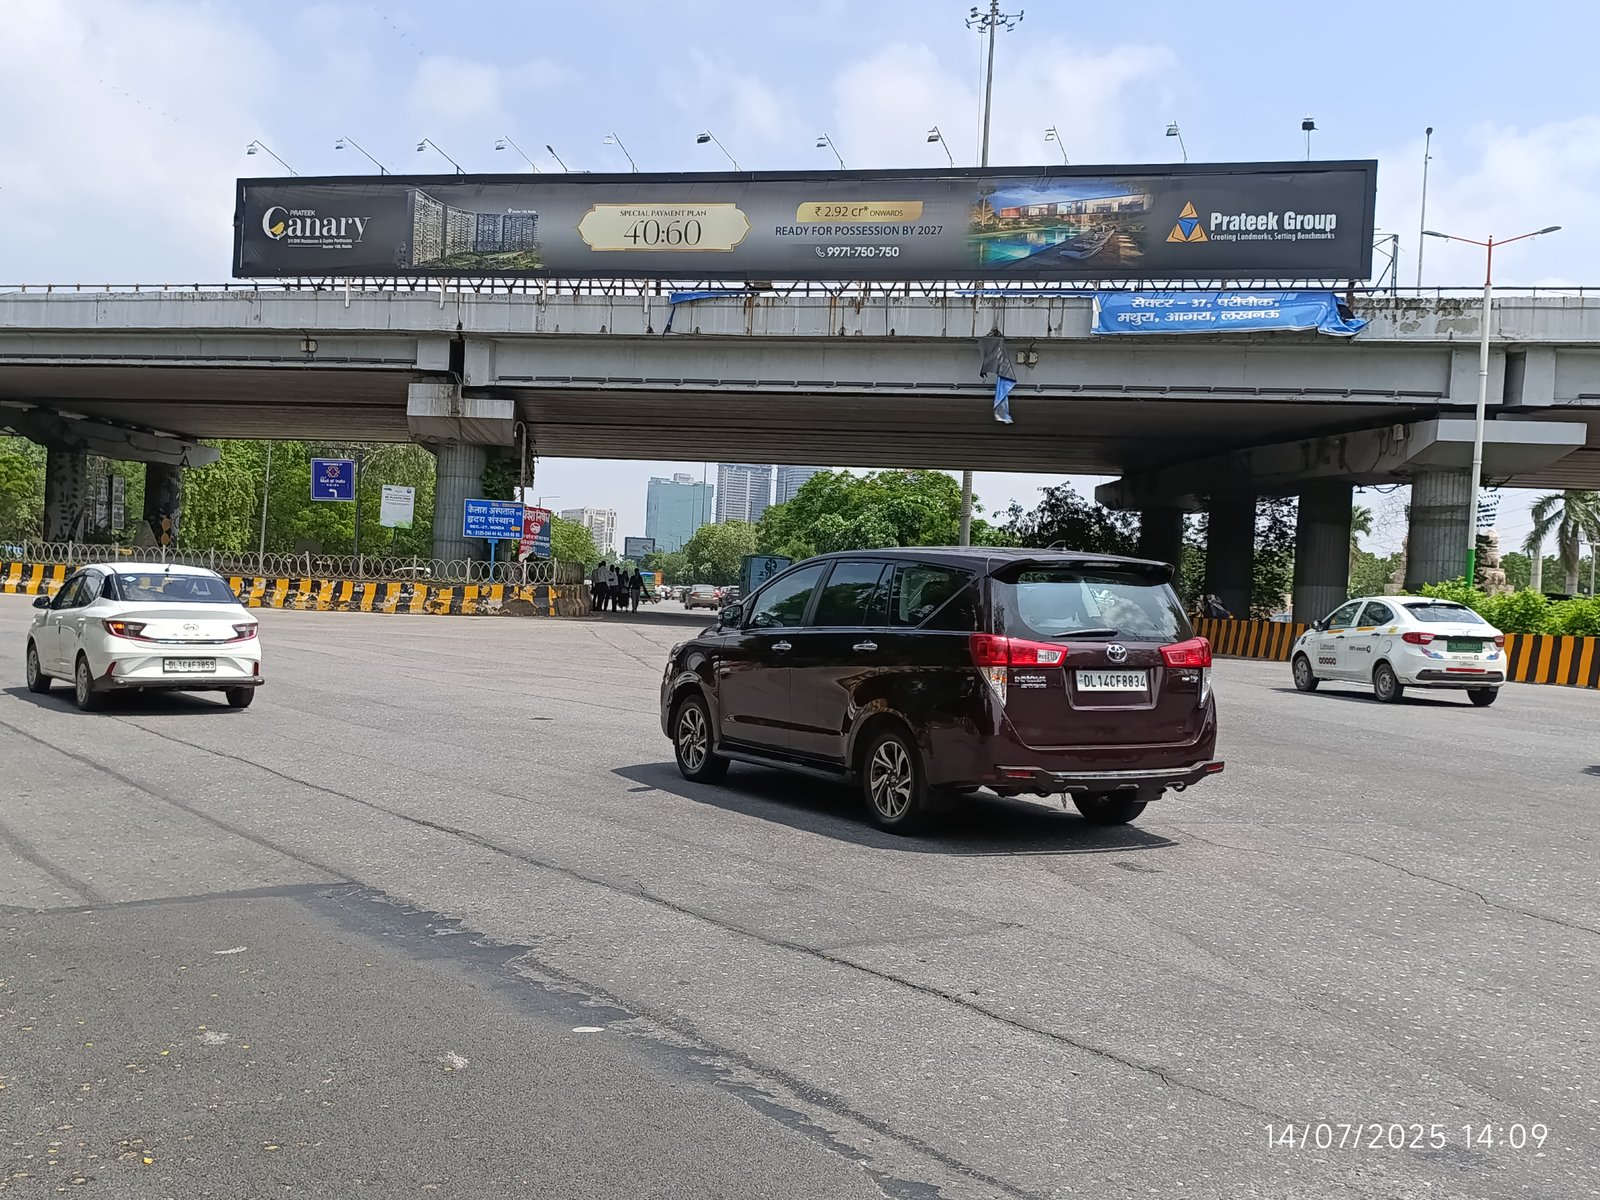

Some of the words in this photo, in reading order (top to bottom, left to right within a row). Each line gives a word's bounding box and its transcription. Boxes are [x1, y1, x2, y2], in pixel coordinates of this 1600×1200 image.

[825, 206, 848, 217] 2.92
[262, 206, 372, 242] Canary
[1210, 211, 1279, 231] Prateek
[1284, 211, 1337, 232] Group
[623, 219, 702, 246] 40:60
[775, 226, 810, 236] READY
[812, 226, 832, 236] FOR
[834, 226, 900, 236] POSSESSION
[902, 226, 916, 236] BY
[917, 225, 943, 235] 2027
[1210, 232, 1237, 242] Creating
[1238, 232, 1273, 241] Landmarks,
[1274, 232, 1296, 242] Setting
[1298, 231, 1335, 240] Benchmarks
[826, 246, 900, 258] 9971-750-750
[1131, 297, 1174, 308] सेक्टर
[1191, 298, 1212, 308] 37,
[1117, 312, 1160, 325] मथुरा,
[1164, 311, 1216, 322] आगरा,
[1221, 310, 1281, 320] लखनऊ
[1083, 674, 1146, 688] DL14CF8834
